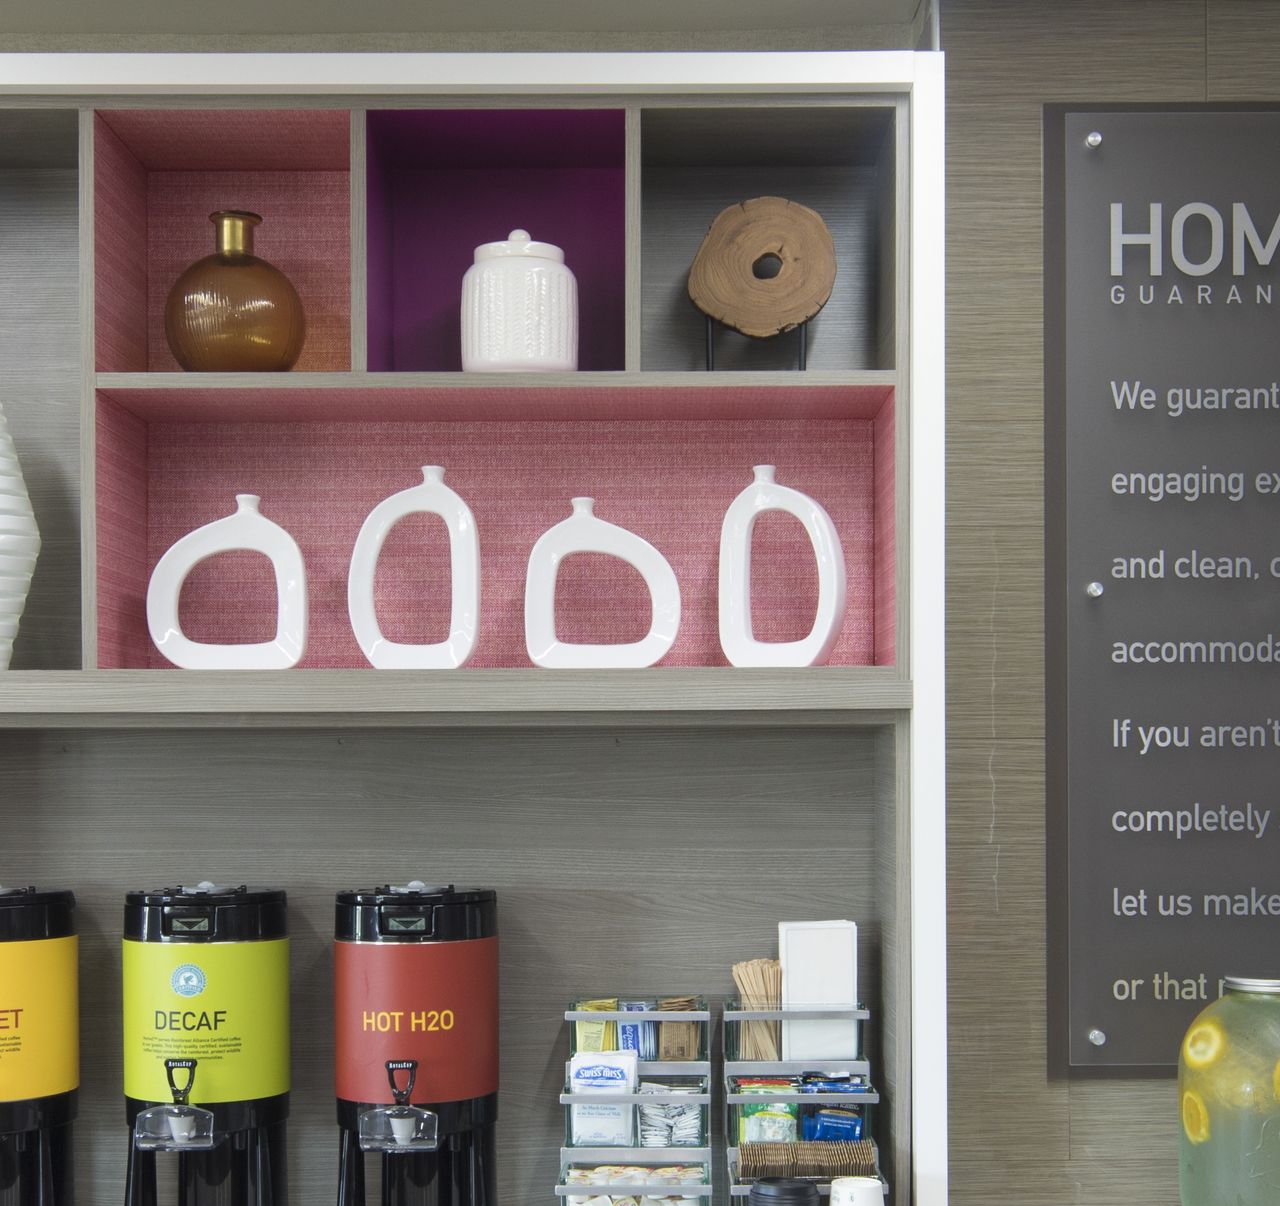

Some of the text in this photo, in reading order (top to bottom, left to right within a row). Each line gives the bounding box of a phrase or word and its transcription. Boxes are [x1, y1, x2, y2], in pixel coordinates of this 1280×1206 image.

[1110, 380, 1156, 410] We
[1111, 464, 1244, 502] engaging
[1111, 549, 1165, 579] and
[1174, 549, 1259, 580] clean,
[1113, 719, 1130, 748] If
[1138, 726, 1190, 755] you
[1111, 802, 1271, 840] completely
[1113, 887, 1148, 917] let
[1158, 894, 1193, 916] us
[1112, 979, 1144, 1001] or
[1152, 971, 1207, 1000] that
[154, 1010, 227, 1031] DECAF
[363, 1011, 404, 1032] HOT
